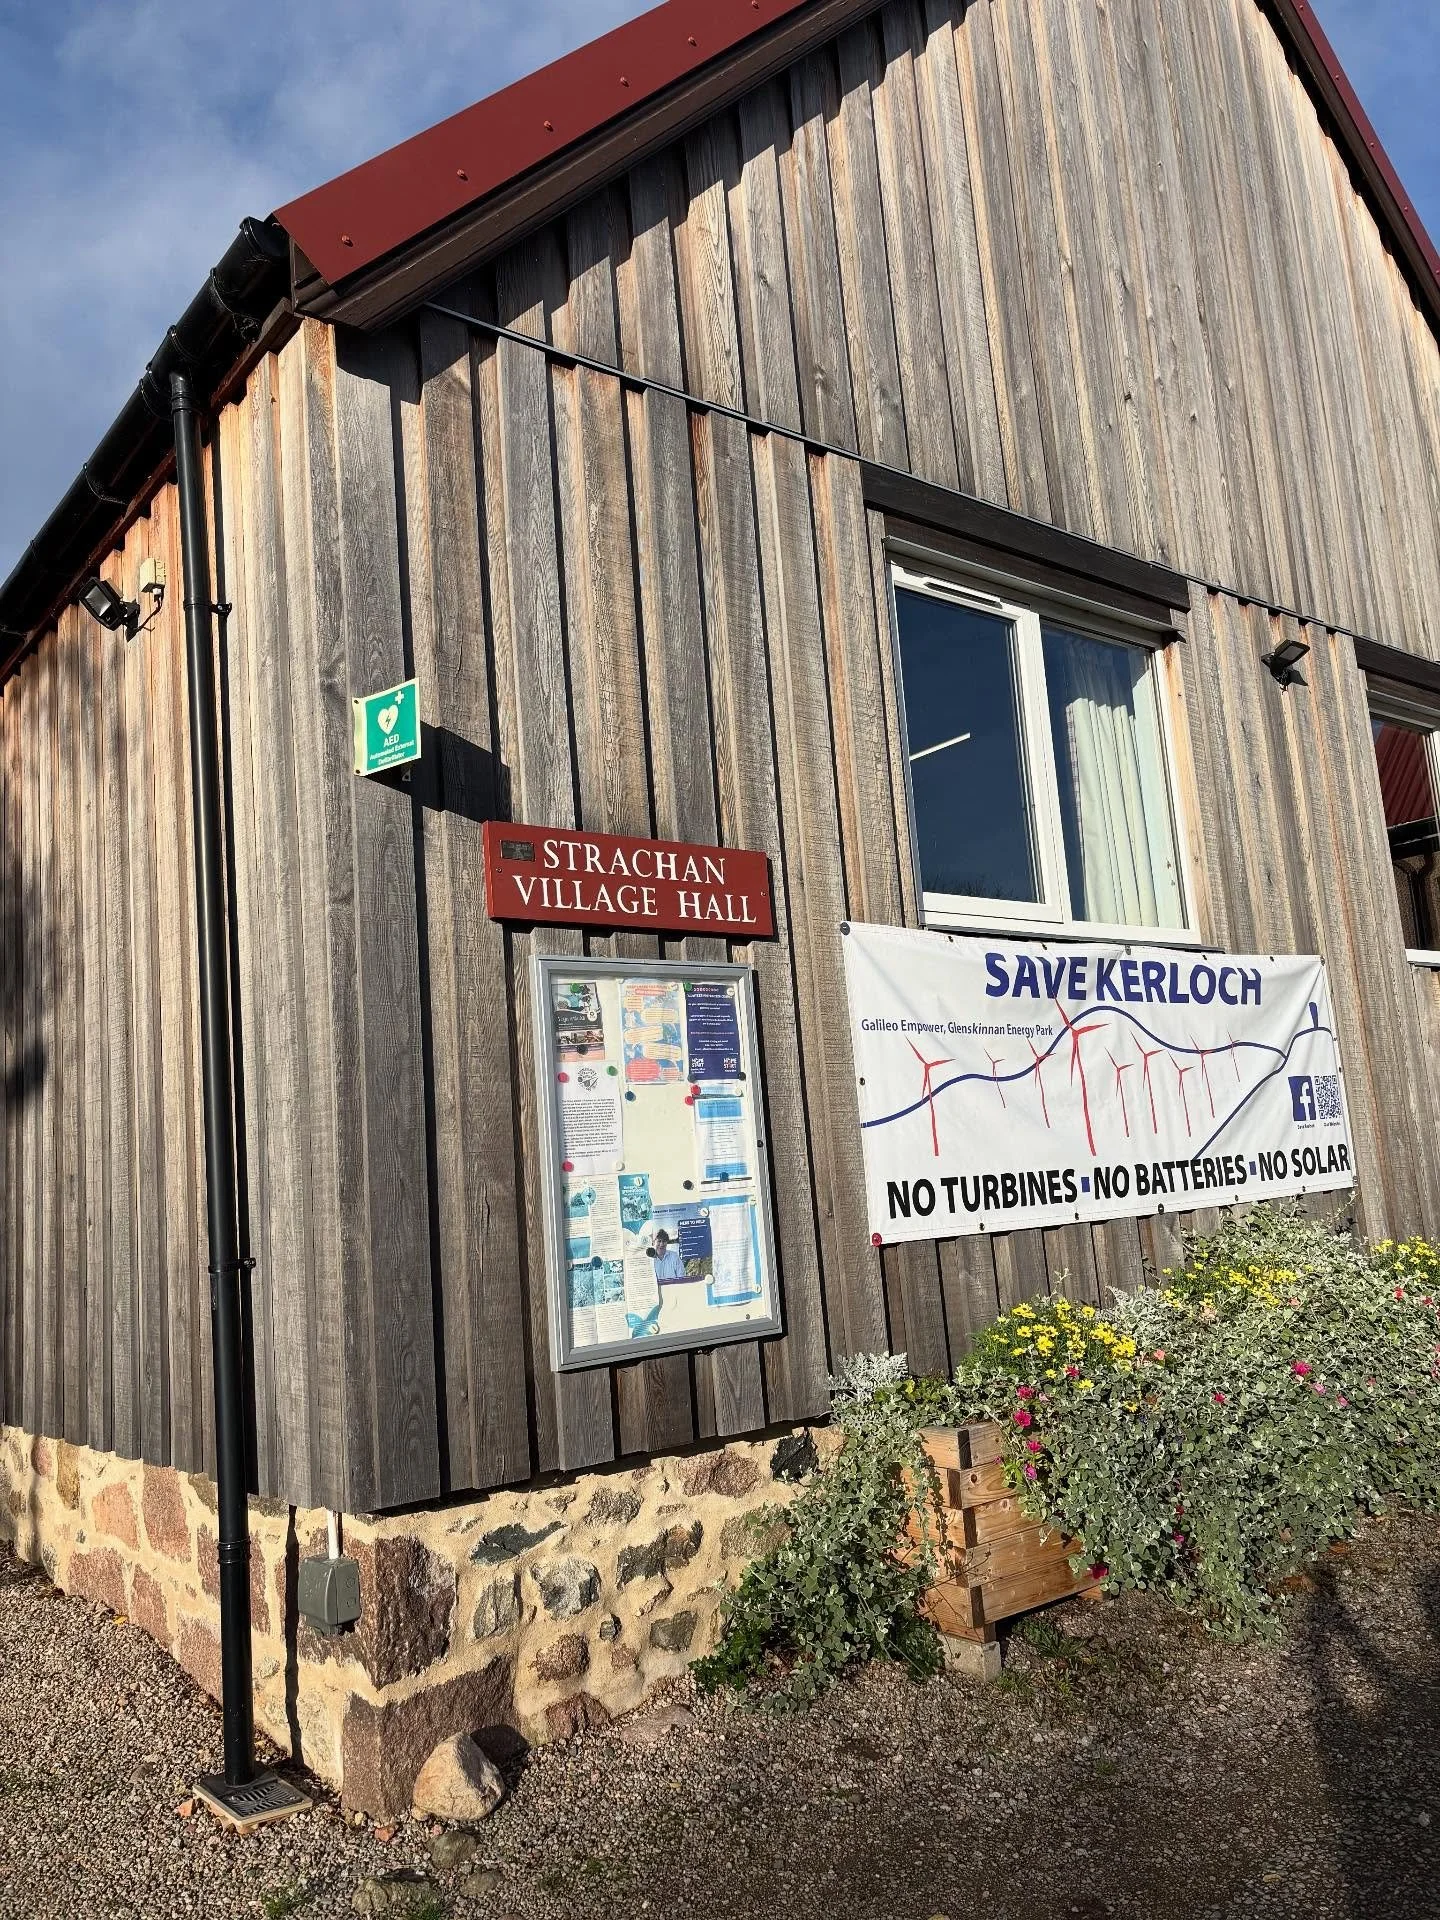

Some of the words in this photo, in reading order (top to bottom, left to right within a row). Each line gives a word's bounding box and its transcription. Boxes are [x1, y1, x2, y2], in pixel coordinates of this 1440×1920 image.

[383, 733, 400, 748] AED
[543, 839, 726, 885] STRACHAN
[513, 875, 658, 916] VILLAGE
[677, 890, 757, 923] HALL
[984, 952, 1088, 1000] SAVE
[1096, 957, 1262, 1006] KERLOCH
[861, 1018, 899, 1032] Galileo
[901, 1019, 946, 1035] Empower,
[947, 1022, 1005, 1036] Glenskinnan
[1007, 1023, 1035, 1039] Energy
[1036, 1025, 1054, 1036] Park
[886, 1178, 936, 1219] NO
[940, 1168, 1078, 1213] TURBINES
[1093, 1164, 1130, 1200] NO
[1134, 1154, 1248, 1196] BATTERIES
[1258, 1150, 1288, 1182] NO
[1293, 1143, 1352, 1178] SOLAR
